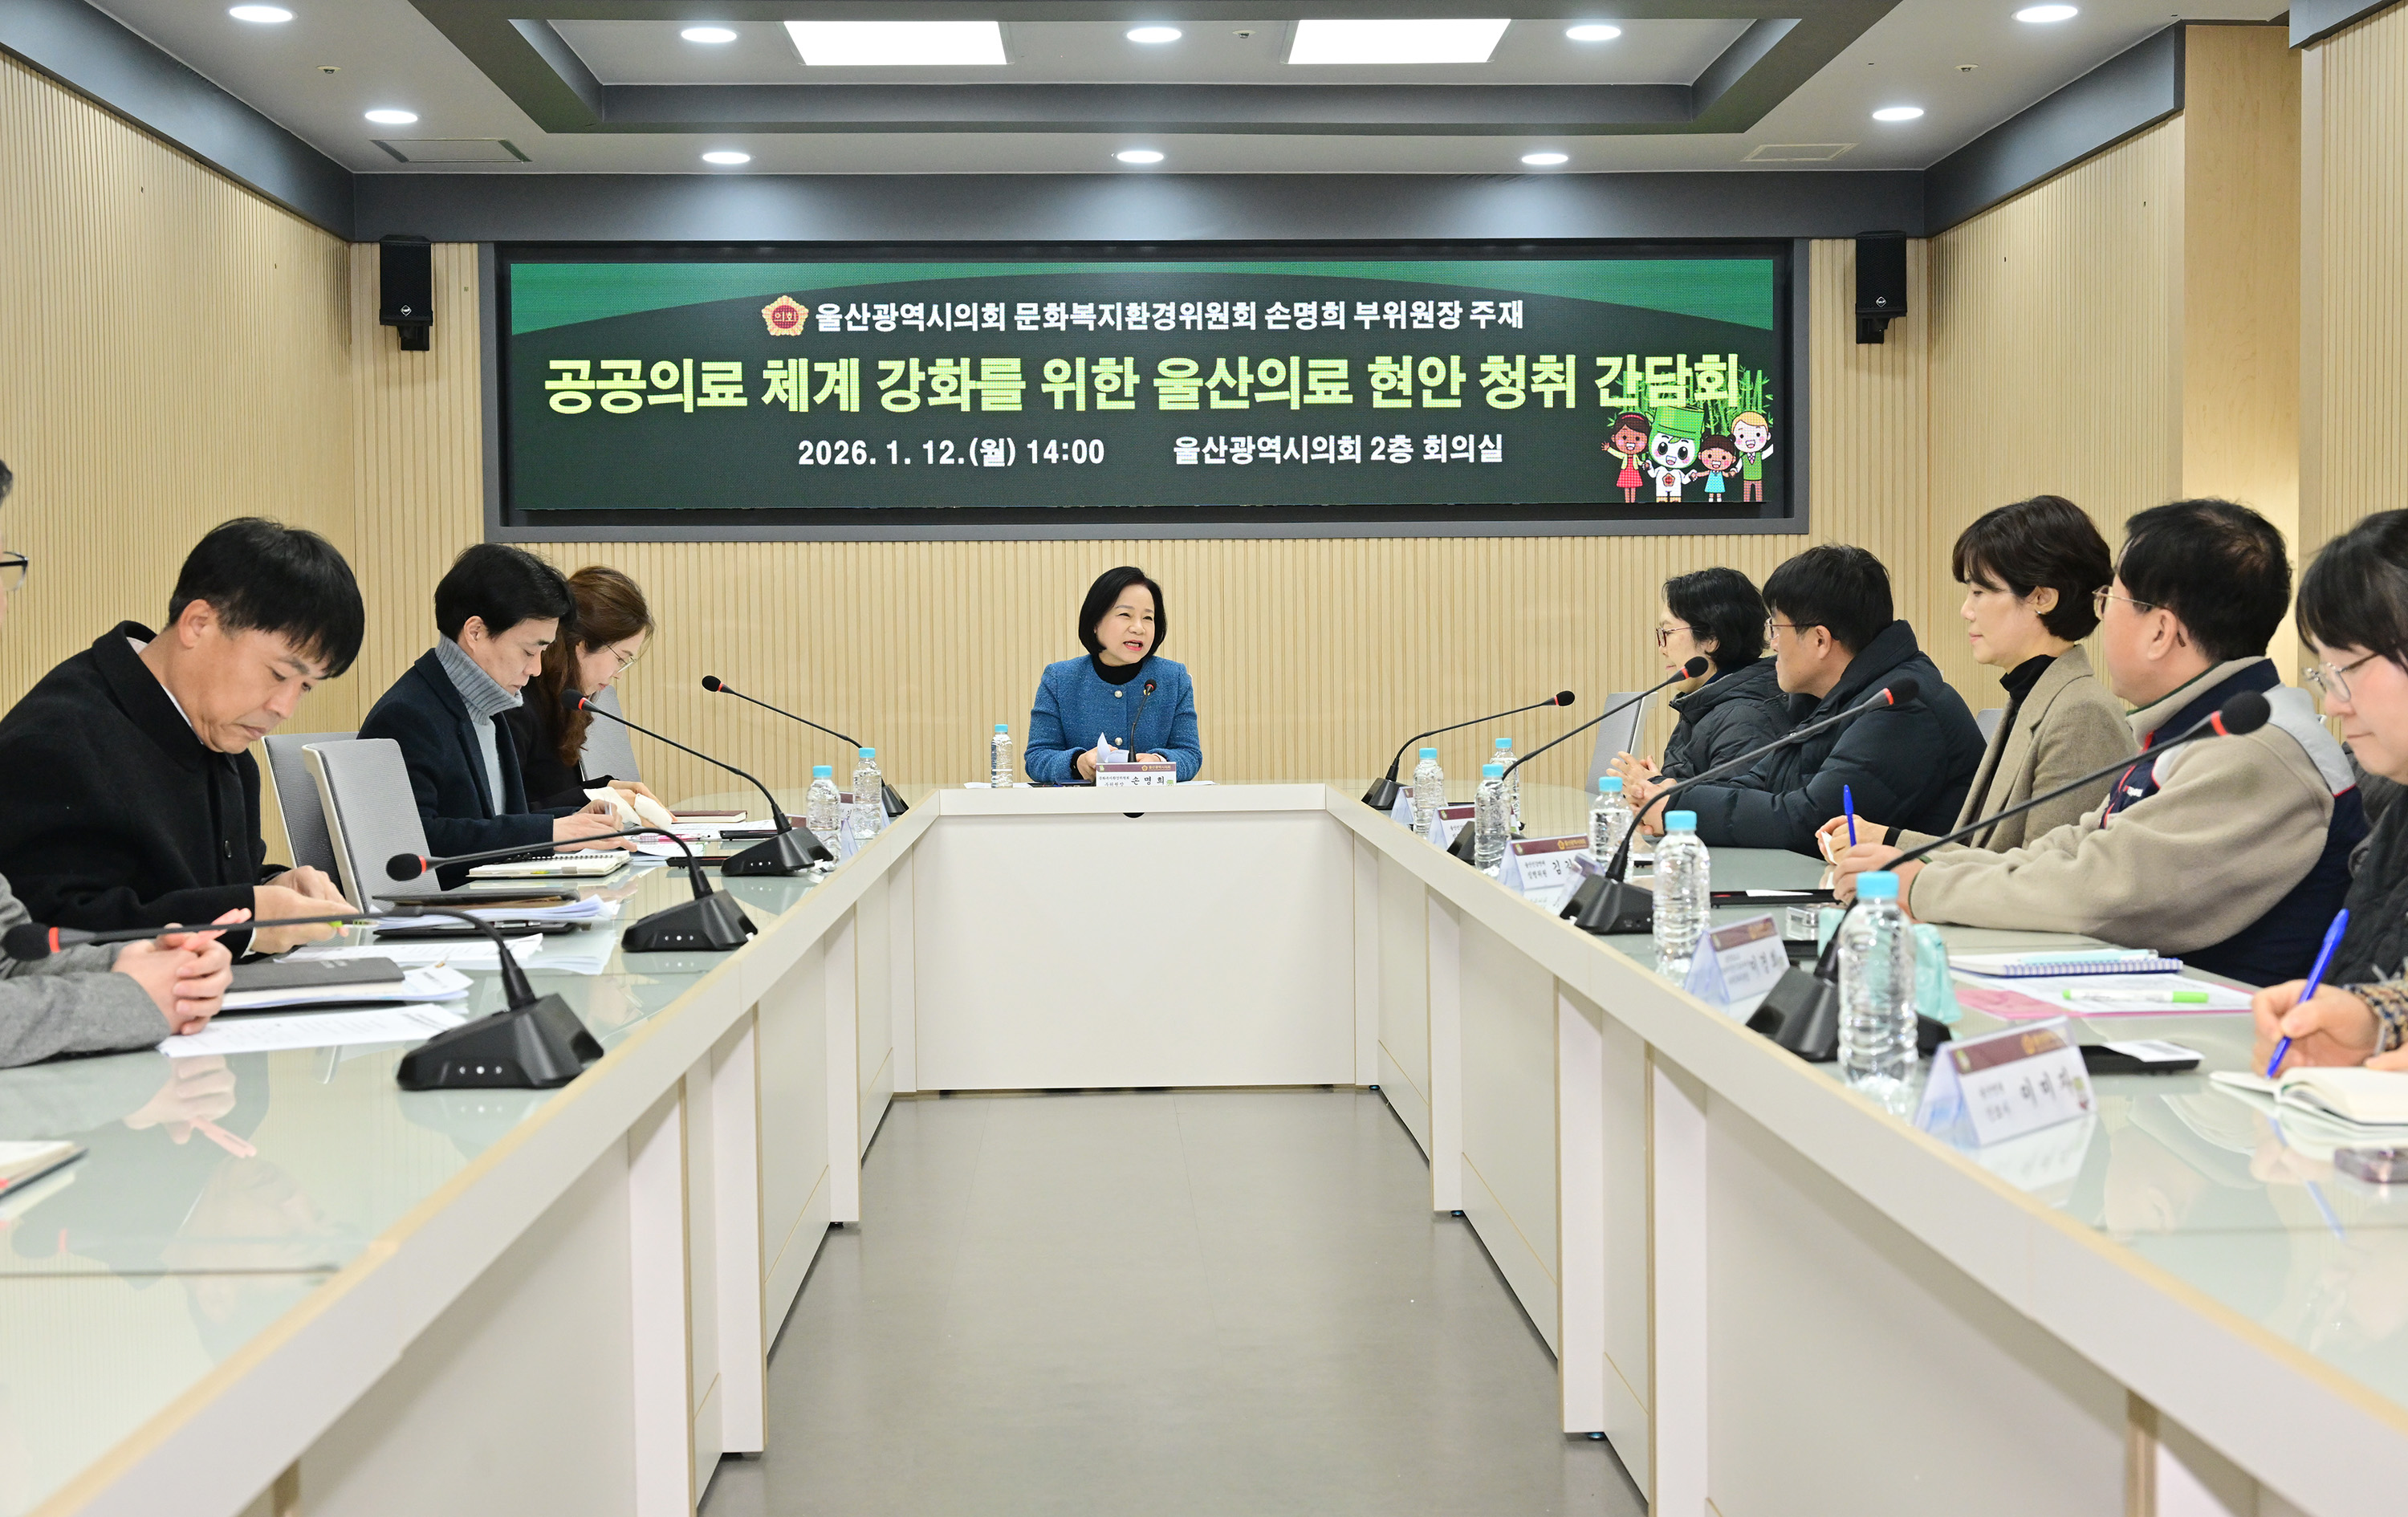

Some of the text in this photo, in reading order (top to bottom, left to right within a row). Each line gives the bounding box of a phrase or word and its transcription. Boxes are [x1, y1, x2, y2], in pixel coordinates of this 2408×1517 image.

[774, 311, 796, 322] 의회
[816, 300, 1524, 332] 울산광역시의회 문화복지환경위원회 손명희 부위원장 주재
[545, 354, 1740, 415] 공공의료 체계 강화를 위한 울산의료 현안 청취 간담회
[799, 437, 1105, 468] 2026. 1. 12.(월) 14:00
[1173, 434, 1503, 466] 울산광역시의회 2층 회의실
